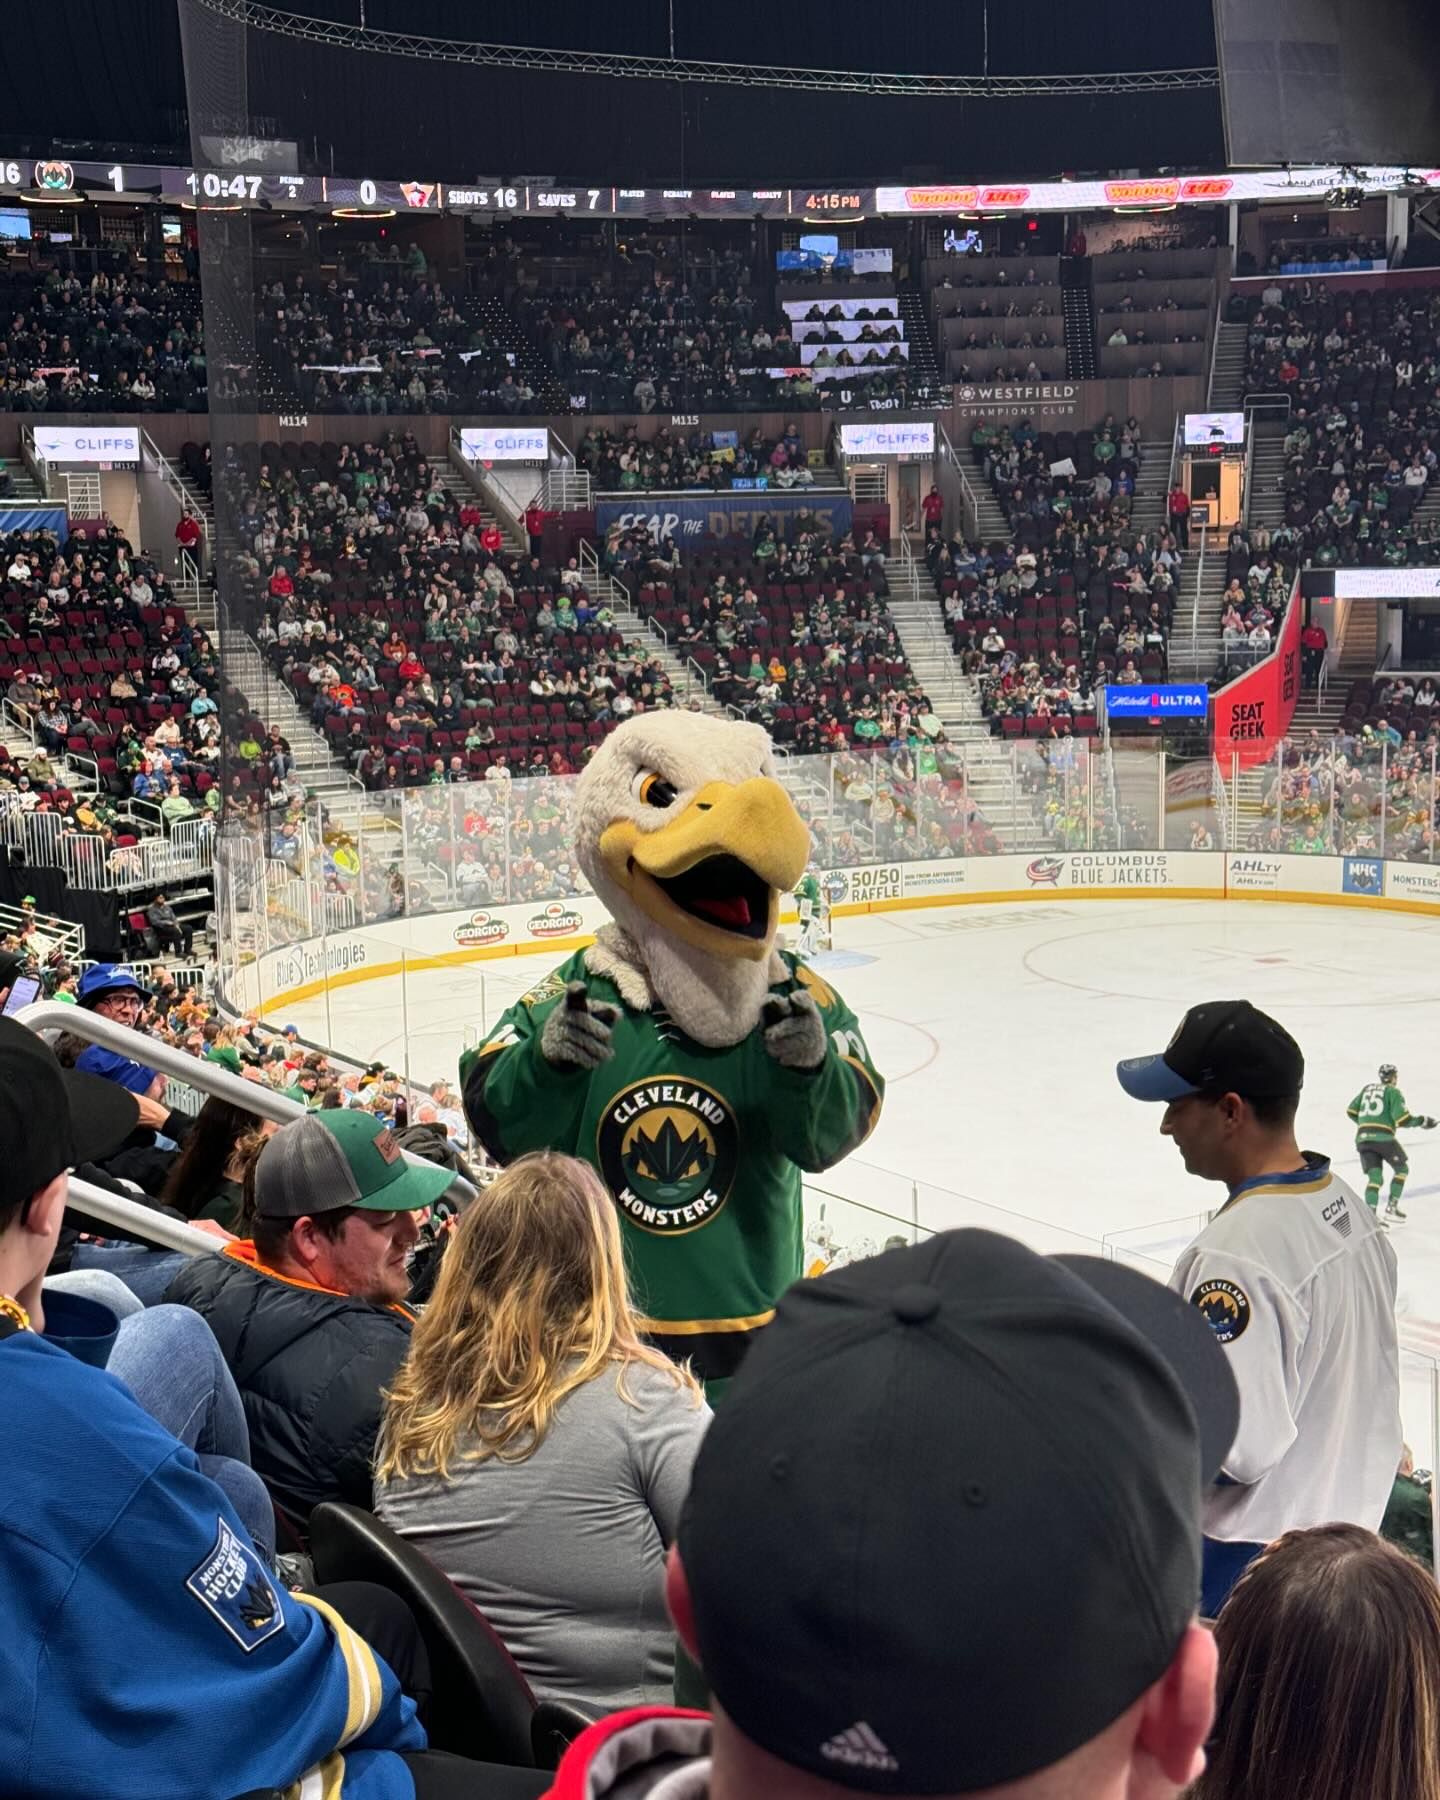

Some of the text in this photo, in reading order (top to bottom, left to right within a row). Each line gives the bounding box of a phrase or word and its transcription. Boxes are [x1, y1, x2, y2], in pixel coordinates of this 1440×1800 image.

[108, 166, 123, 192] 1
[186, 172, 262, 199] 10:47
[288, 185, 297, 198] 2
[360, 180, 376, 205] 0
[448, 188, 517, 208] SHOTS 16
[537, 190, 600, 210] SAVES 7
[806, 194, 860, 209] 4:15 PM
[978, 386, 1075, 400] WESTFIELD
[961, 405, 1074, 417] CHAMPIONS CLUB
[279, 415, 308, 427] M114
[671, 415, 699, 426] M115
[75, 438, 135, 450] CLIFFS
[494, 439, 544, 450] CLIFFS
[876, 433, 930, 444] CLIFFS
[682, 519, 704, 536] THE
[708, 509, 833, 539] DEPTS
[1159, 695, 1201, 706] ULTRA
[1231, 702, 1264, 722] SEAT
[1230, 721, 1265, 741] GEEK
[1071, 856, 1167, 867] COLUMBUS
[1349, 863, 1377, 877] MHC
[851, 869, 899, 888] 50/50
[1071, 868, 1168, 884] BLUE JACKETS
[1393, 874, 1438, 887] MONSTERS
[852, 885, 900, 902] RAFFLE
[454, 922, 508, 940] GEORGIO'S
[526, 915, 581, 931] GEORGIO'S
[276, 959, 294, 987] Blue
[613, 1085, 725, 1126] CLEVELAND
[618, 1187, 719, 1226] MONSTERS
[1321, 1195, 1346, 1222] CCM
[1200, 1281, 1247, 1307] CLEVELAND
[224, 1556, 247, 1599] CLUB
